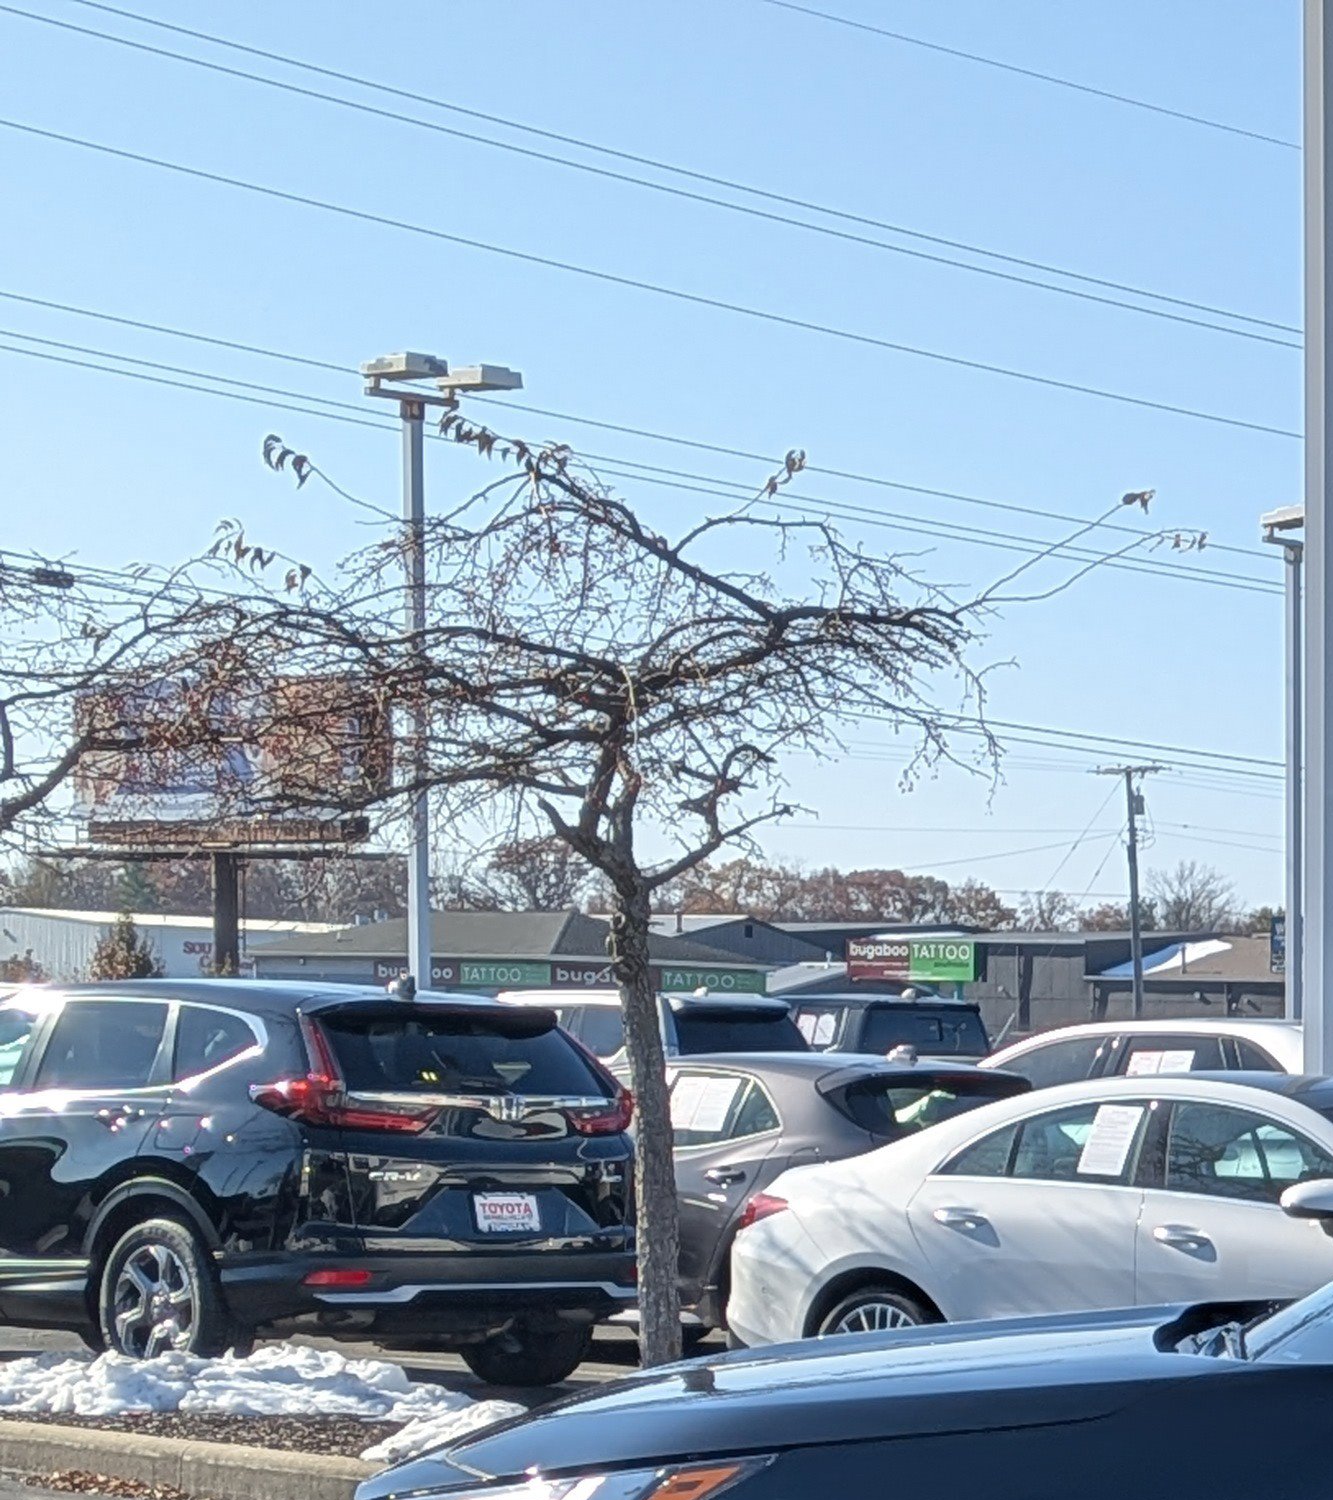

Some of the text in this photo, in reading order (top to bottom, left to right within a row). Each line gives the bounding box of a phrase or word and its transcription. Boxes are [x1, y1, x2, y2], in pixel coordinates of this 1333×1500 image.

[850, 942, 970, 960] bugaboo TATTOO
[463, 967, 521, 981] TATTOO
[664, 972, 735, 988] TATTOO
[370, 1171, 421, 1181] CR-V
[479, 1202, 532, 1214] TOYOTA
